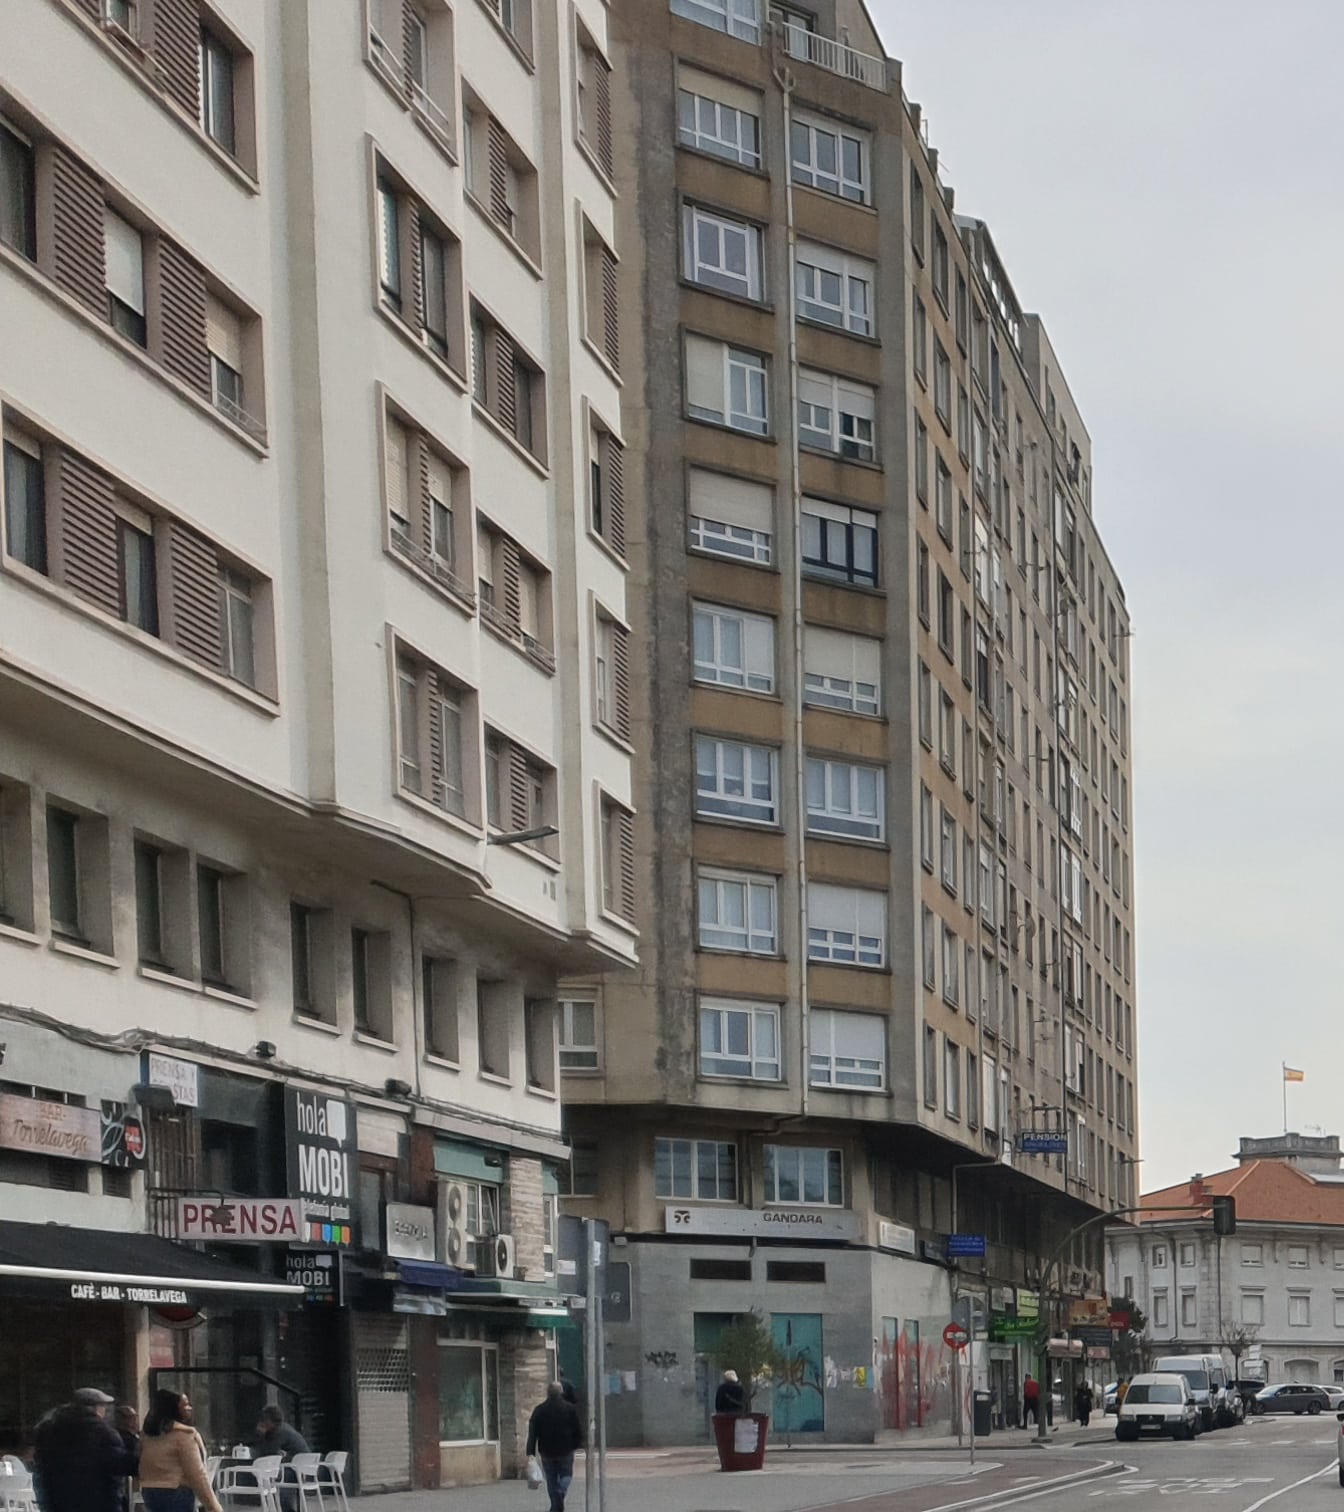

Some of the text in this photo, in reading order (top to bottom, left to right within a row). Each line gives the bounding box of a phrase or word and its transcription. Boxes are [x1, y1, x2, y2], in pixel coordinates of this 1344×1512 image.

[296, 1091, 327, 1137] hola
[1023, 1133, 1067, 1142] PENSION
[298, 1143, 350, 1199] MOBI
[183, 1204, 297, 1235] PRENSA
[763, 1212, 823, 1225] GANDARA
[286, 1254, 316, 1269] hola
[286, 1271, 330, 1286] MOBI
[101, 1286, 120, 1300] BAR
[126, 1287, 188, 1304] TORRELAVEGA
